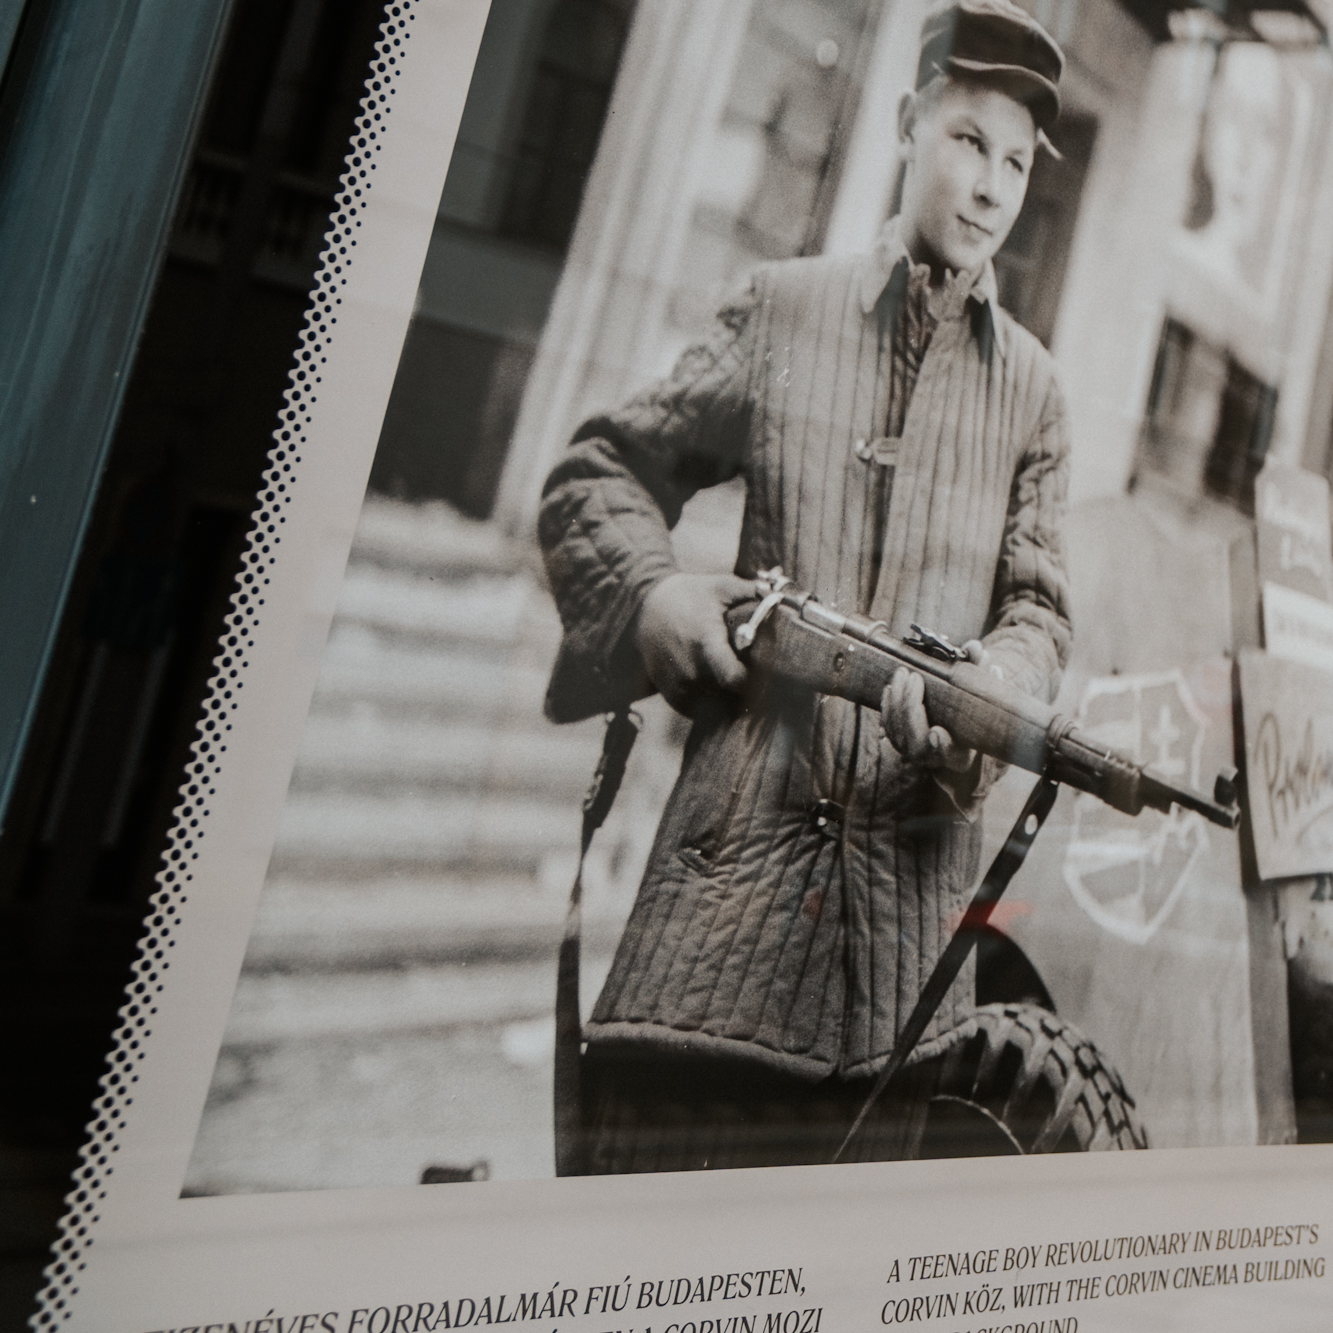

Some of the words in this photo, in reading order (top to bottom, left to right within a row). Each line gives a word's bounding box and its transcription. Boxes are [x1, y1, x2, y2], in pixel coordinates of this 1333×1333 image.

[886, 1258, 902, 1285] A
[907, 1249, 1000, 1283] TEENAGE
[1003, 1244, 1043, 1273] BOY
[1044, 1231, 1193, 1268] REVOLUTIONARY
[1192, 1229, 1213, 1253] IN
[1215, 1223, 1320, 1252] BUDAPEST'S
[347, 1281, 579, 1333] FORRADALMÁR
[583, 1274, 632, 1315] FIÚ
[636, 1267, 807, 1310] BUDAPESTEN,
[880, 1290, 959, 1325] CORVIN
[961, 1282, 1007, 1317] KÖZ,
[1011, 1280, 1061, 1311] WITH
[1064, 1275, 1102, 1304] THE
[1103, 1268, 1171, 1298] CORVIN
[1172, 1263, 1239, 1289] CINEMA
[1242, 1256, 1327, 1285] BUILDING
